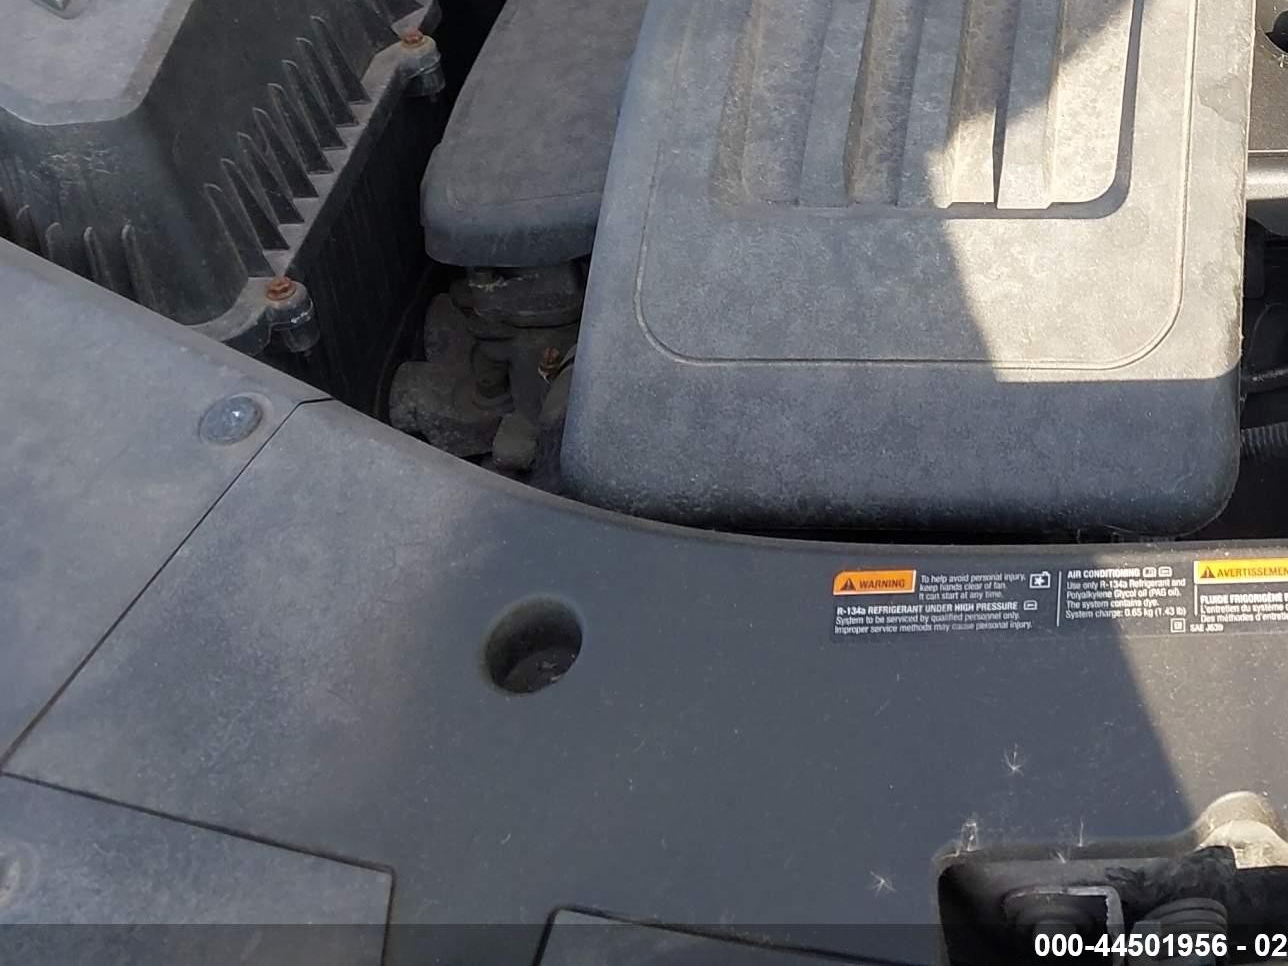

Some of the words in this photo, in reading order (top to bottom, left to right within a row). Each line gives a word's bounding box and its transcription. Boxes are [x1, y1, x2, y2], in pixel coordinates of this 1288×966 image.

[921, 575, 929, 583] To
[931, 574, 947, 583] help
[949, 574, 969, 582] avoid
[971, 573, 1002, 582] personal
[1067, 570, 1082, 578] AIR
[1083, 568, 1140, 578] CONDITIONING
[860, 579, 905, 588] WARNING
[920, 584, 938, 592] keep
[940, 583, 962, 591] hands
[1066, 581, 1080, 590] Use
[1083, 581, 1098, 590] only
[1100, 580, 1128, 588] R-134a
[1172, 578, 1186, 587] and
[1066, 590, 1112, 600] Polyalkylene
[1114, 589, 1136, 599] Glycol
[1149, 588, 1166, 597] (PAG
[1066, 600, 1080, 609] The
[1082, 600, 1109, 609] system
[1110, 599, 1142, 608] contains
[1200, 595, 1229, 604] FLUIDE
[837, 606, 866, 615] R-134a
[868, 605, 924, 614] REFRIGERANT
[925, 604, 952, 613] UNDER
[954, 603, 974, 612] HIGH
[976, 601, 1018, 611] PRESSURE
[1065, 609, 1093, 619] System
[1095, 608, 1123, 618] charge:
[1124, 607, 1142, 617] 0.65
[1144, 607, 1153, 618] kg
[1155, 607, 1175, 616] (1.43
[1241, 604, 1251, 612] du
[836, 616, 864, 626] System
[866, 616, 873, 624] to
[875, 615, 884, 623] be
[886, 615, 918, 623] serviced
[920, 614, 929, 623] by
[931, 613, 963, 622] qualified
[965, 613, 1001, 621] personnel
[1200, 614, 1216, 623] Des
[835, 625, 869, 634] Improper
[900, 624, 932, 632] methods
[934, 624, 949, 632] may
[976, 622, 1008, 630] personal
[1190, 624, 1204, 632] SAE
